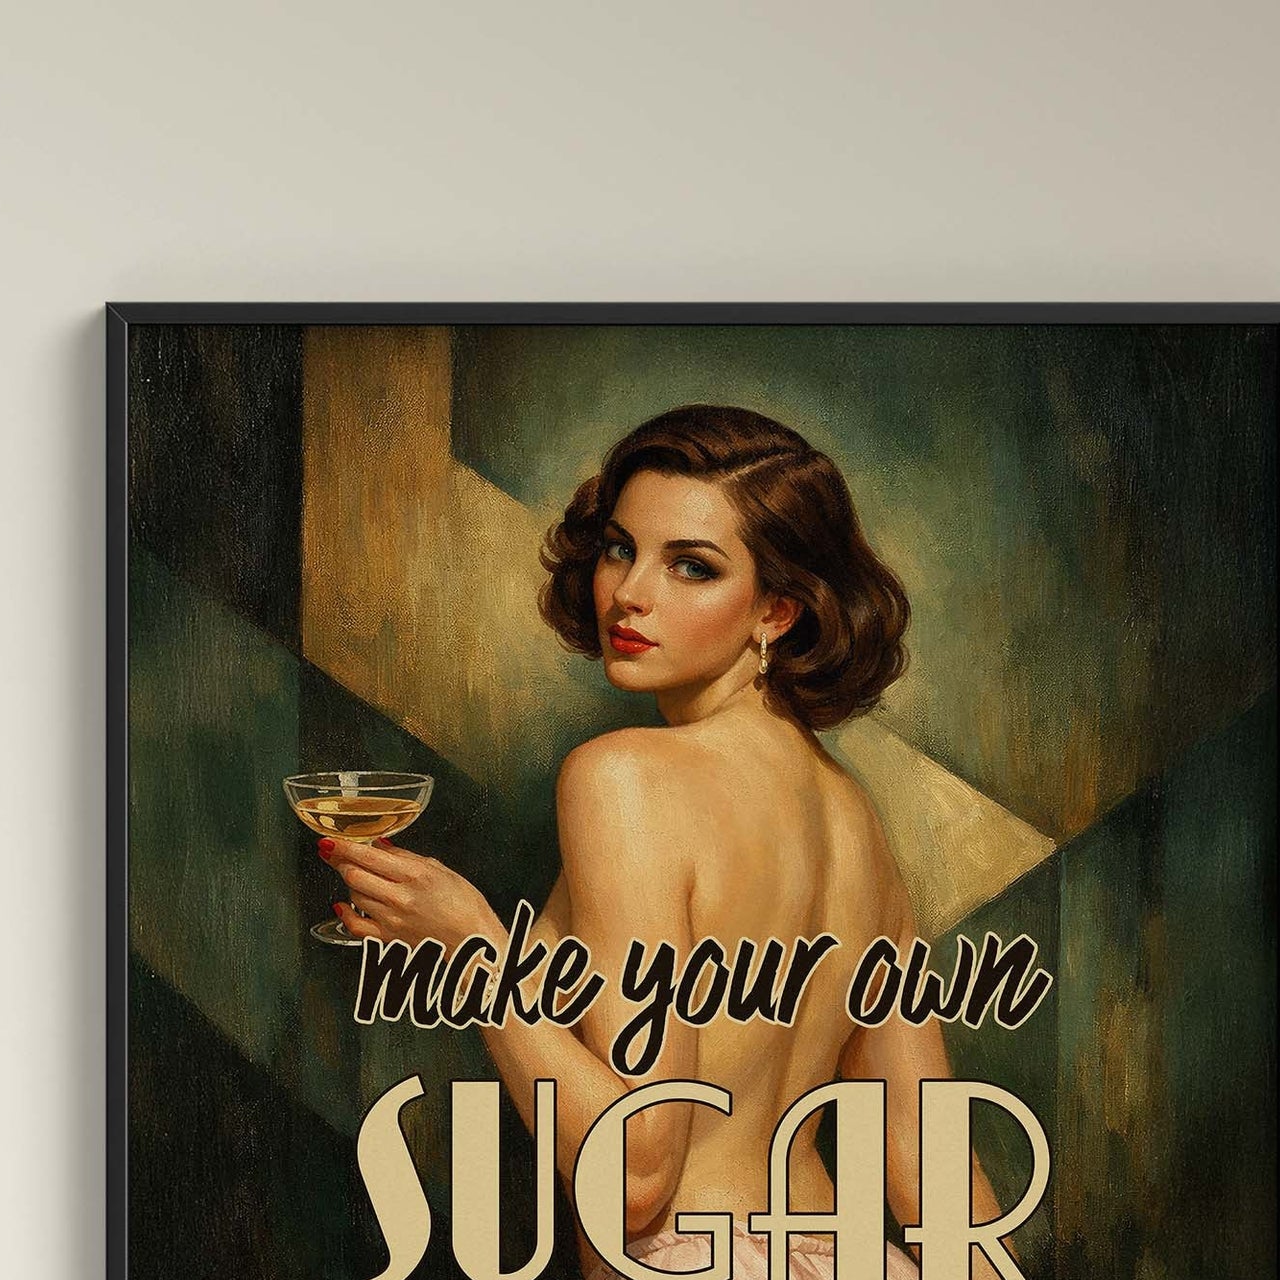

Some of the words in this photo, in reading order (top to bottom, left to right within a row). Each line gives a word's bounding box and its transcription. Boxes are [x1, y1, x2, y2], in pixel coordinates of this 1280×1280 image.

[354, 900, 605, 1031] make
[608, 932, 839, 1077] your
[850, 932, 1051, 1031] own
